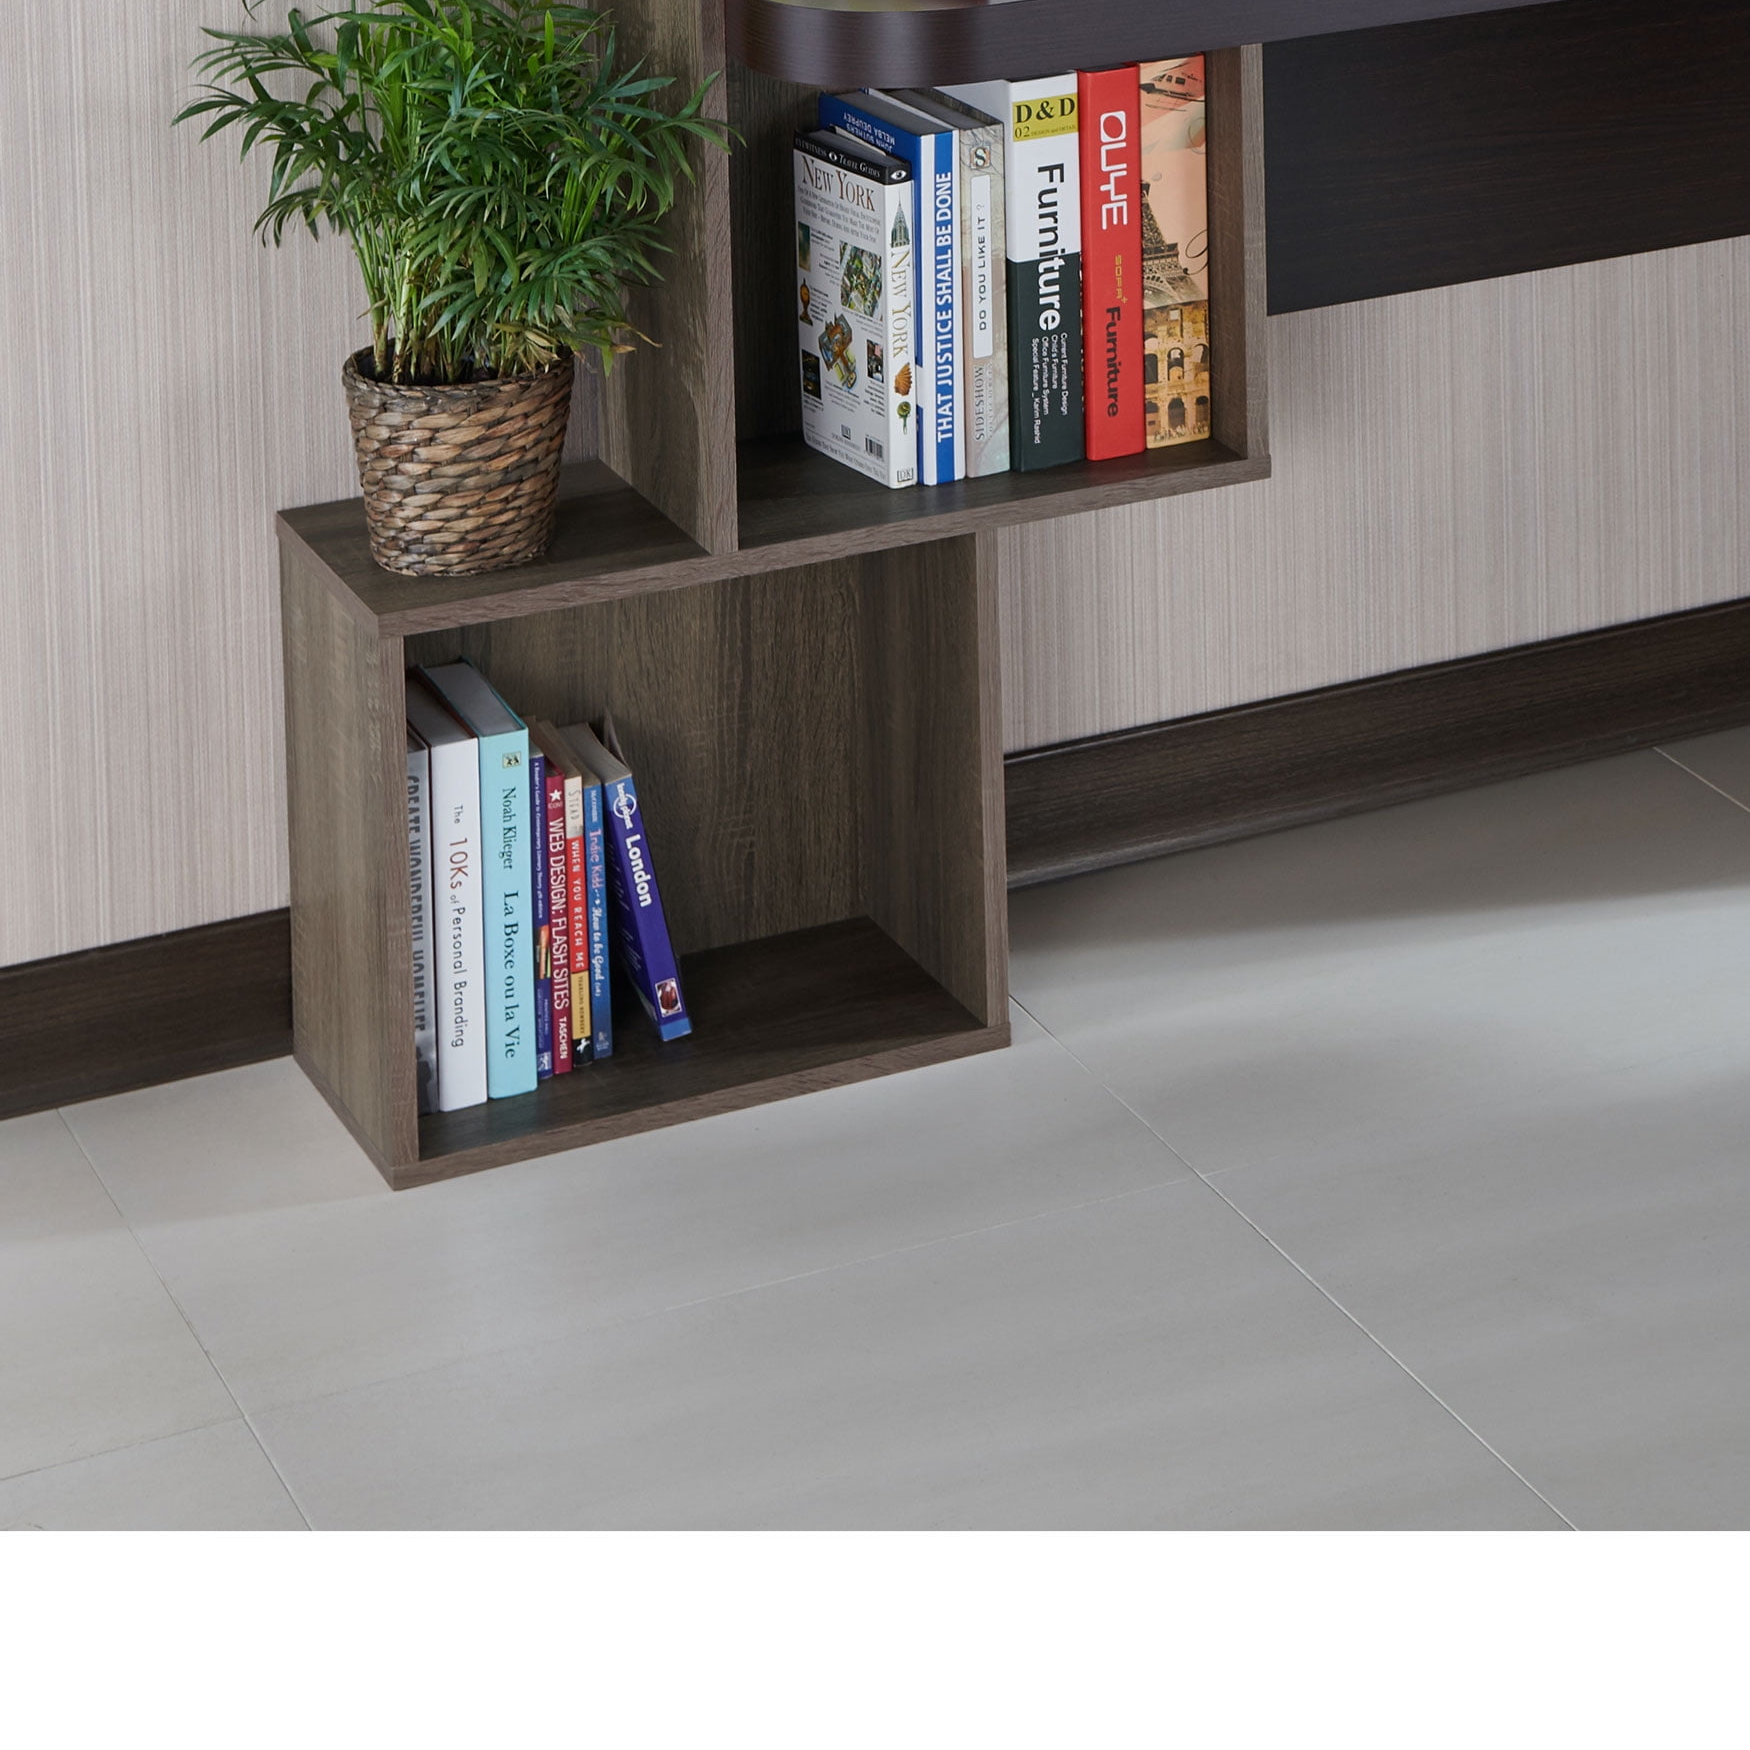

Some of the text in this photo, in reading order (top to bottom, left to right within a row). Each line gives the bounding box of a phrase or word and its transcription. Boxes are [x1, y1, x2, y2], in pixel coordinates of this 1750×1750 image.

[1015, 104, 1032, 123] D
[1058, 97, 1075, 117] D
[801, 154, 834, 194] NEW
[835, 169, 876, 212] YORK
[977, 217, 986, 230] IT
[977, 235, 986, 269] LIKE
[1037, 162, 1066, 331] Furniture
[891, 250, 912, 358] NEW YORK
[936, 171, 953, 443] THAT JUSTICE SHALL BE DONE
[979, 275, 987, 305] YOU
[979, 309, 987, 331] DO
[1032, 338, 1040, 363] Special
[1106, 305, 1122, 417] Furniture
[975, 366, 985, 441] SIDESHOW
[1041, 389, 1050, 416] System
[1060, 390, 1069, 416] Design
[499, 787, 517, 870] Noah Klieger
[589, 828, 604, 889] Indie Kidd
[625, 834, 652, 907] London
[449, 805, 469, 1048] The 10Ks of Personal Branding
[571, 840, 585, 968] WHEN YOU REACH ME
[592, 906, 603, 930] How
[549, 817, 570, 1059] WEB DESIGN: FLASH SITES TASCHEN
[593, 932, 602, 942] to
[593, 943, 604, 954] be
[503, 890, 520, 1059] La Boxe ou la Vie
[592, 955, 605, 981] Good
